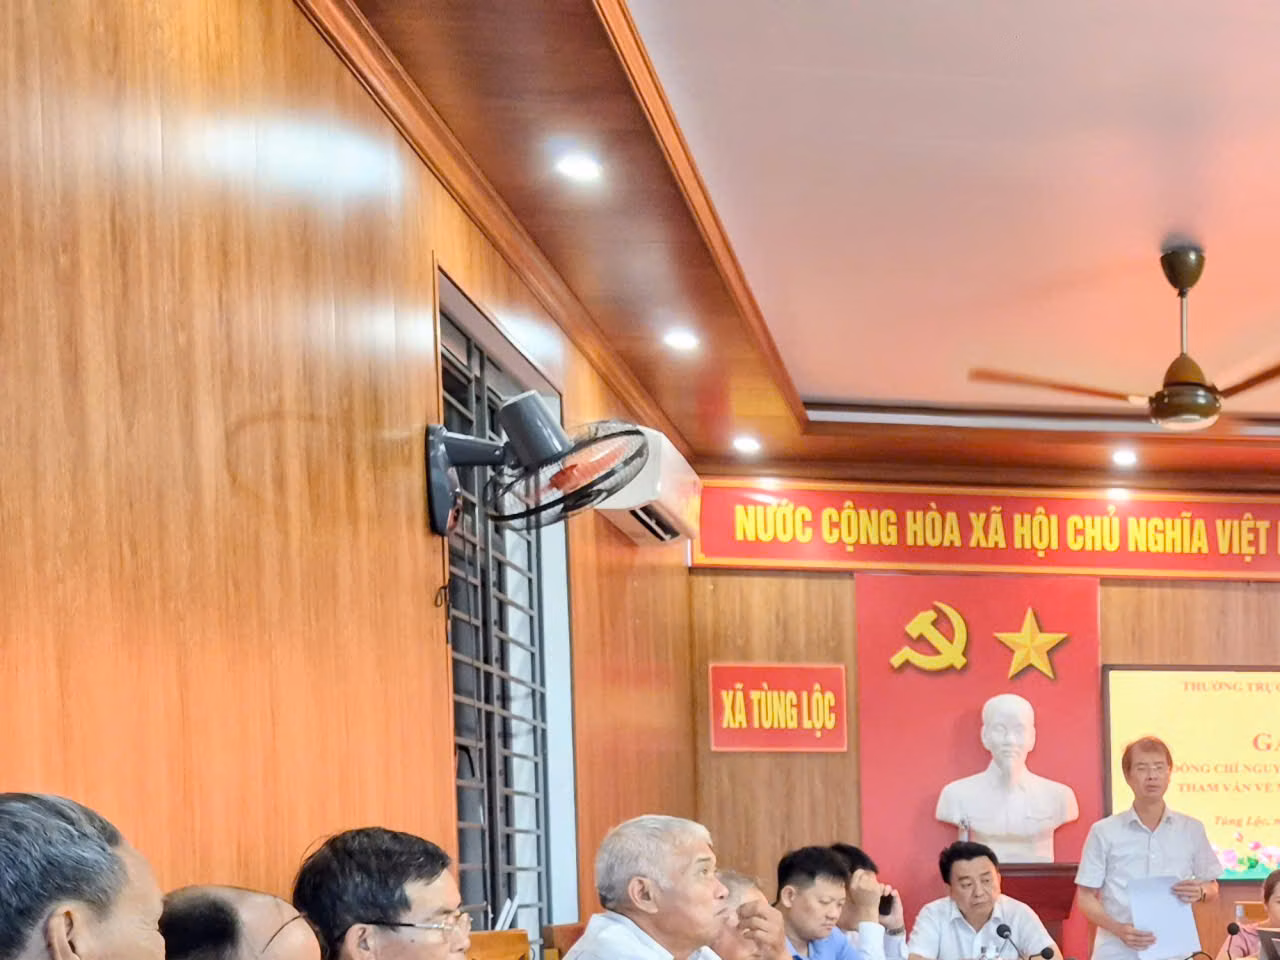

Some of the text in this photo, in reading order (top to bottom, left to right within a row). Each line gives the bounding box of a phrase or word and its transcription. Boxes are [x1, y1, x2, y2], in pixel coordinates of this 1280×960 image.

[735, 498, 813, 543] NƯỚC
[822, 500, 898, 551] CỘNG
[906, 502, 962, 547] HÒA
[969, 506, 1006, 549] XÃ
[1014, 506, 1059, 557] HỘI
[1067, 504, 1119, 552] CHỦ
[1127, 512, 1209, 554] NGHĨA
[1216, 513, 1270, 562] VIỆT
[722, 682, 836, 737] XÃ TÙNG LỘC
[1214, 761, 1239, 773] CHÍ
[1178, 783, 1219, 793] THAM
